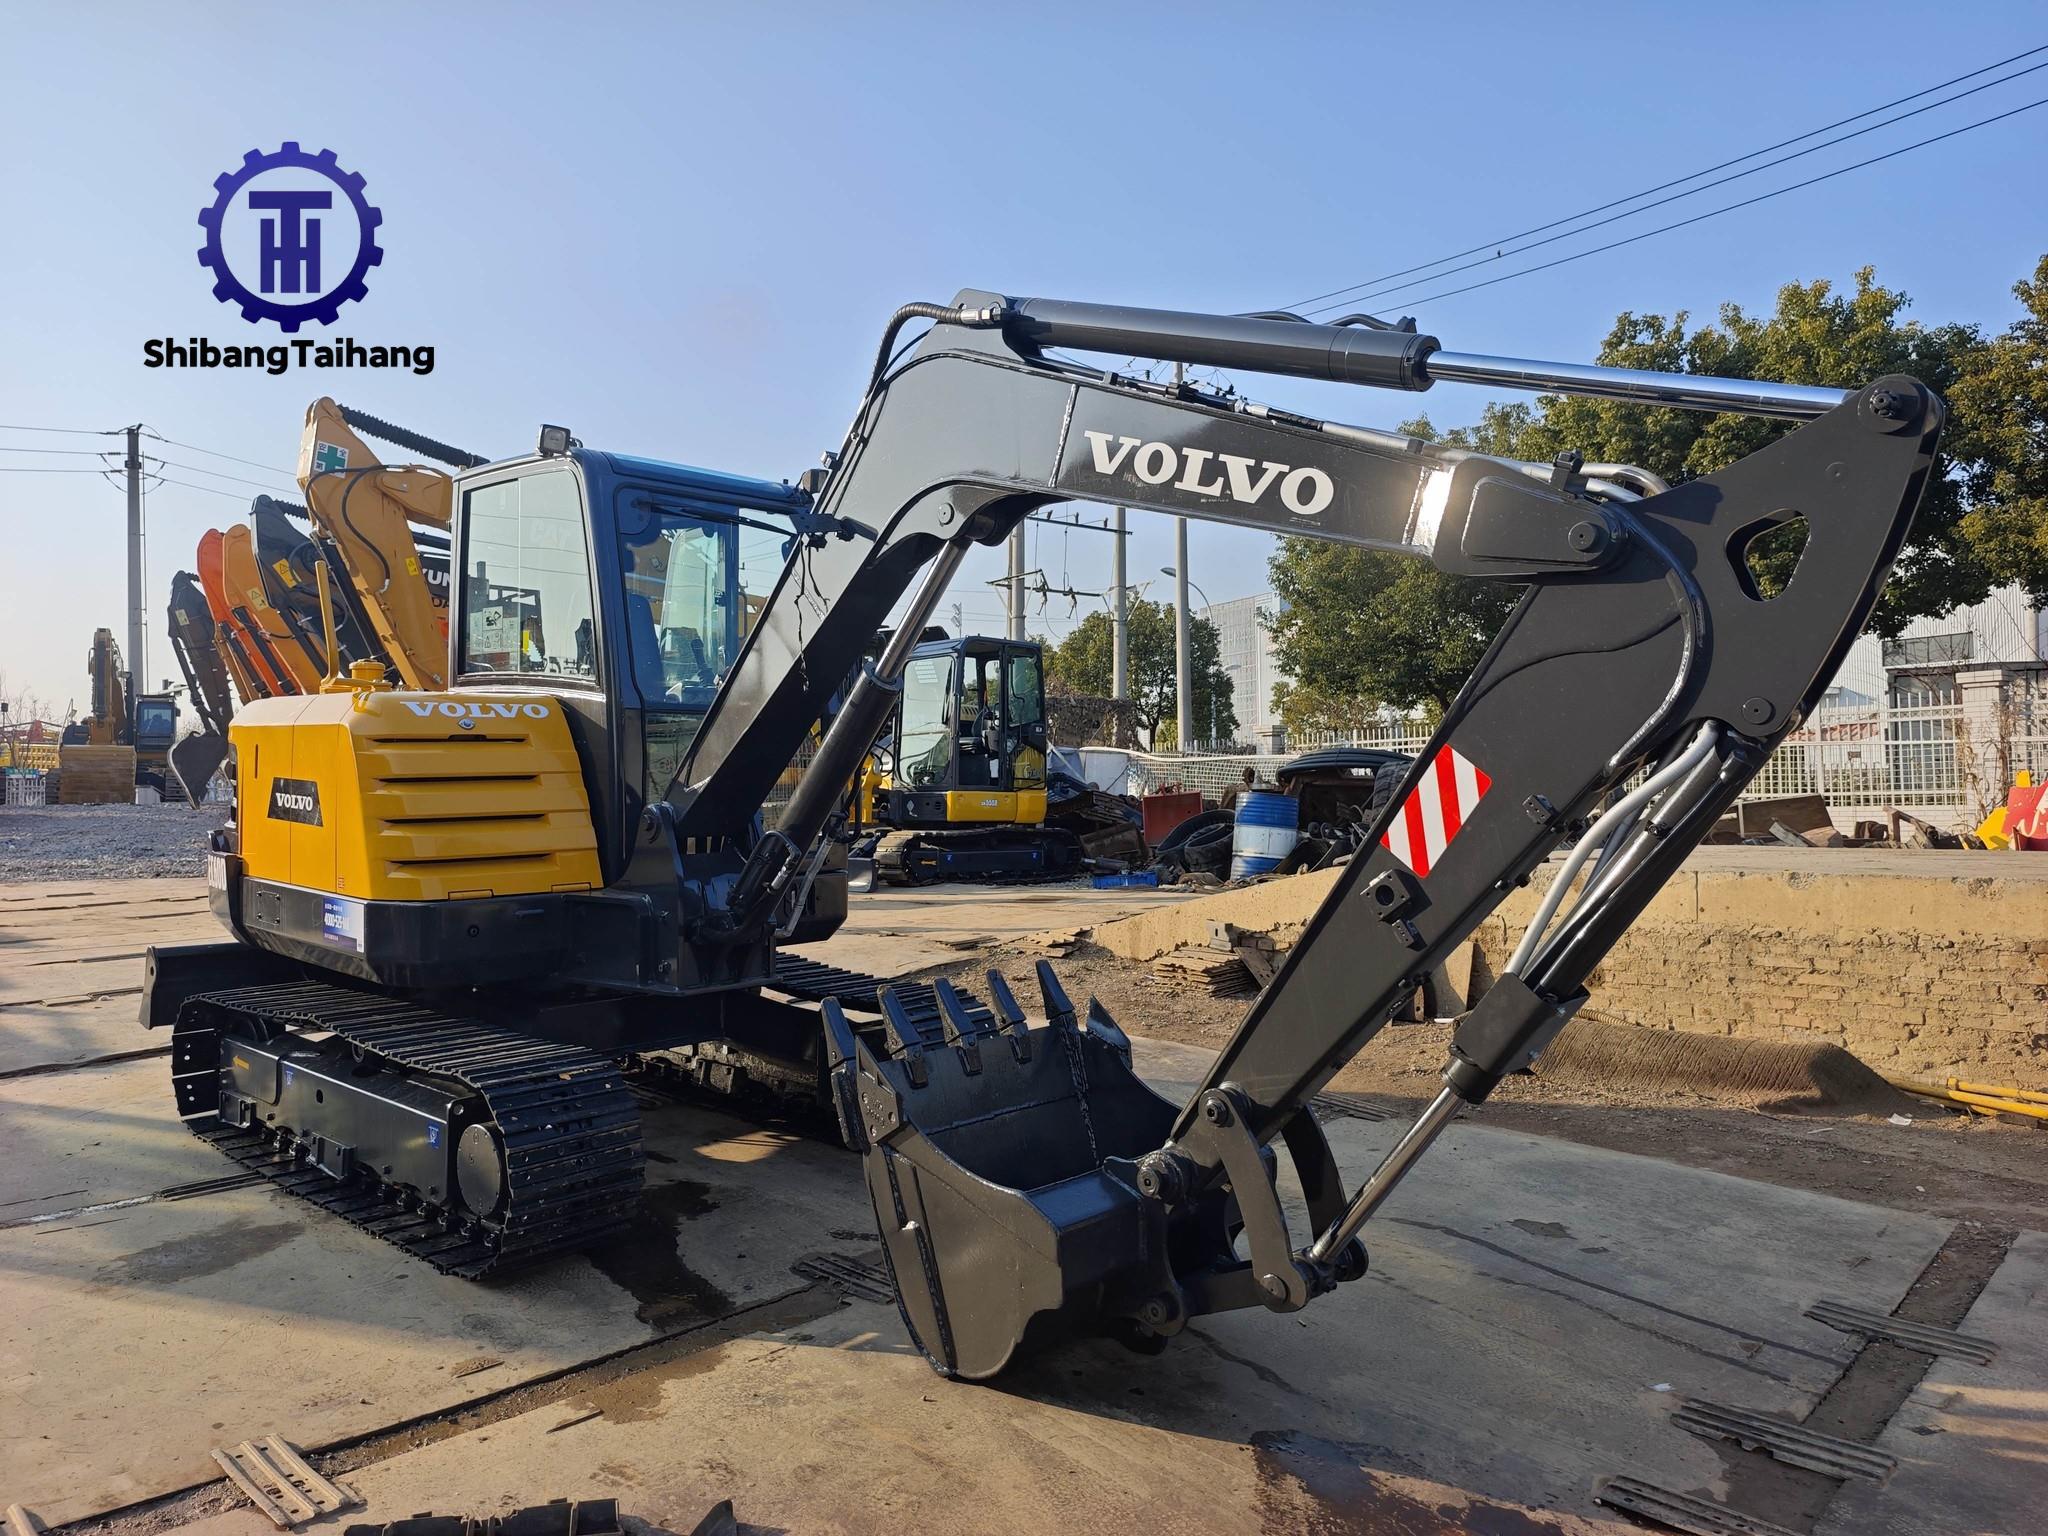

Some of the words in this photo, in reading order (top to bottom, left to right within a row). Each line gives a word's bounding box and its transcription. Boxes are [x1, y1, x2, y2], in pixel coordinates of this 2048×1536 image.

[1084, 430, 1334, 515] VOLVO
[400, 701, 549, 719] VOLVO
[275, 792, 314, 811] VOLVO
